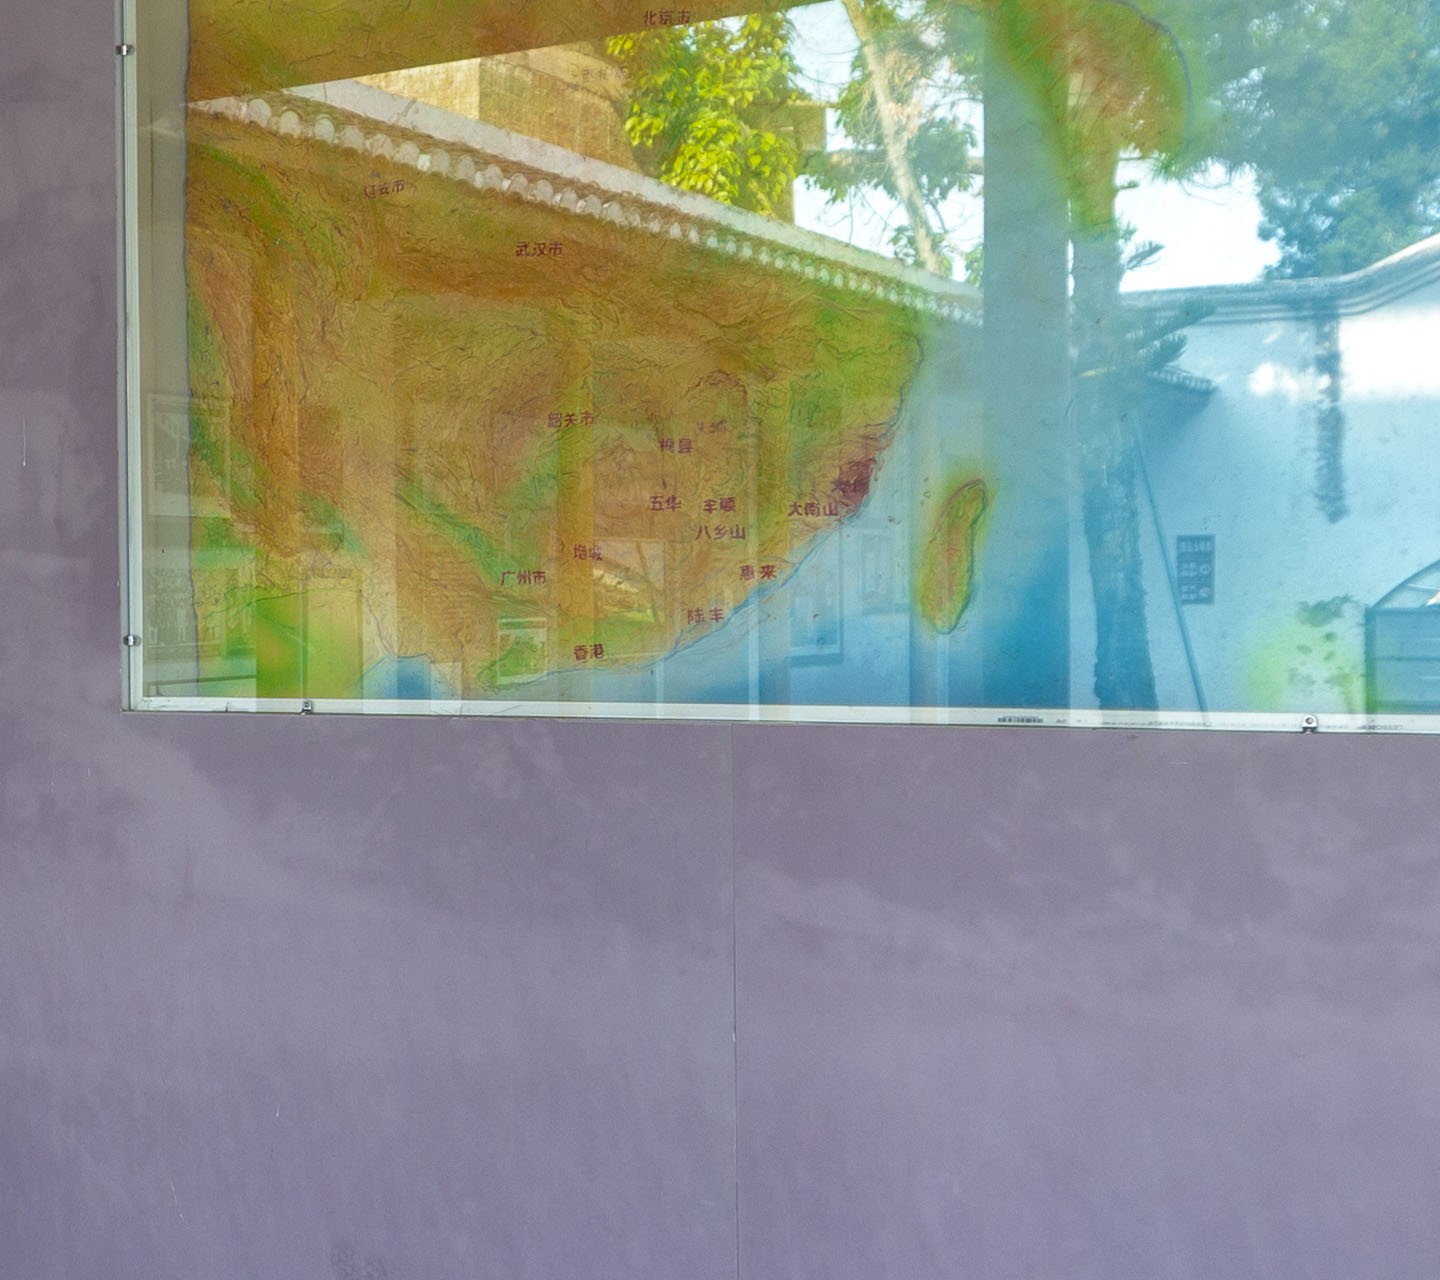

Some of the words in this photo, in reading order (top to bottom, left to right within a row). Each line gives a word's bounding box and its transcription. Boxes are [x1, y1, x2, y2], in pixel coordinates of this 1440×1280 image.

[642, 10, 691, 25] 北京市
[516, 241, 563, 257] 武汉市
[547, 411, 594, 428] 韶关市
[650, 495, 682, 512] 五华
[787, 501, 838, 517] 大南山
[696, 524, 746, 540] 八乡山
[500, 569, 546, 586] 广州市
[740, 564, 777, 580] 惠来
[687, 608, 725, 624] 陆丰
[574, 644, 605, 661] 香港
